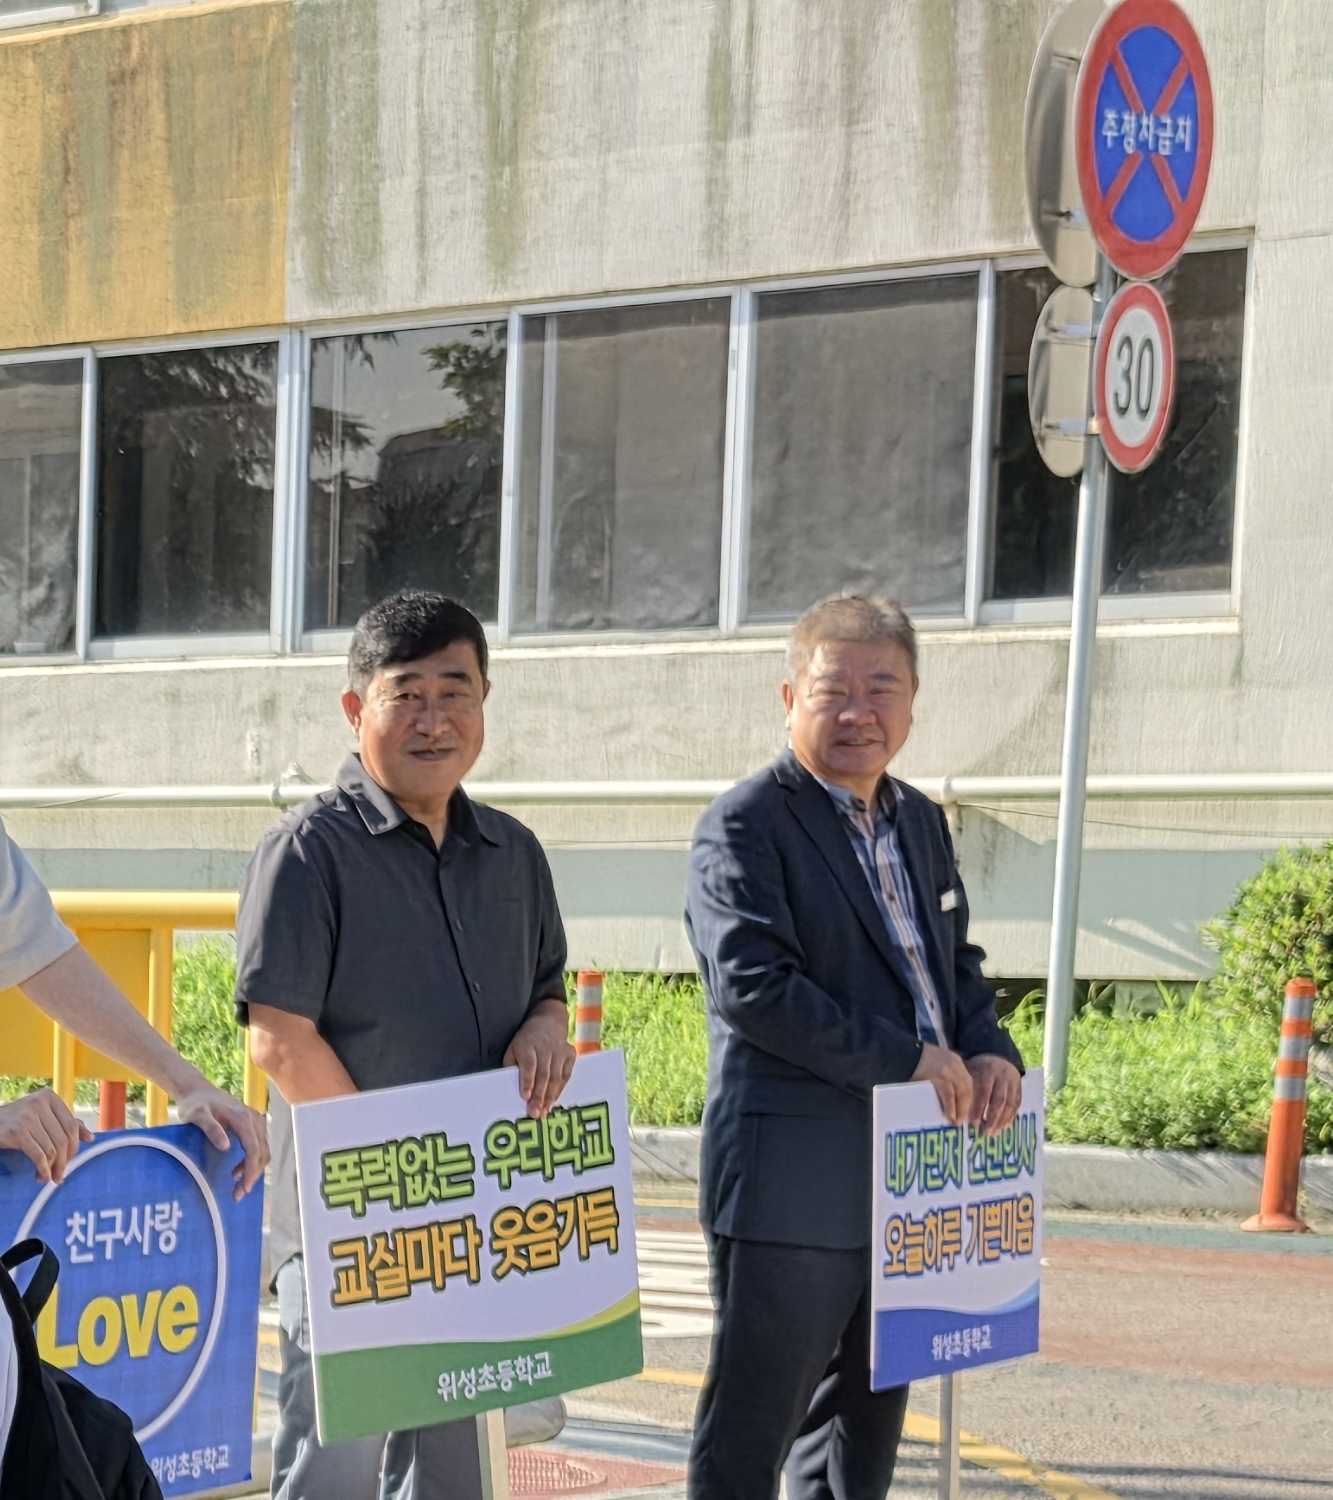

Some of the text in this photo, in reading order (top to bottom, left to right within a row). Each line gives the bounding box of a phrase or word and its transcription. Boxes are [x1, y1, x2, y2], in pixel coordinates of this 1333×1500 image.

[1101, 108, 1191, 156] 주정차금지
[1113, 335, 1155, 419] 30
[321, 1100, 615, 1219] 폭력없는 우리학교
[885, 1124, 963, 1198] 내가먼저
[65, 1201, 182, 1265] 친구사랑
[329, 1185, 620, 1309] 교실마다 웃음가득
[883, 1192, 1035, 1279] 오늘하루 기쁜마음
[37, 1283, 199, 1369] Love
[932, 1323, 992, 1361] 위성초등학교
[437, 1351, 553, 1403] 위성초등학교
[151, 1444, 230, 1484] 위성초등학교
